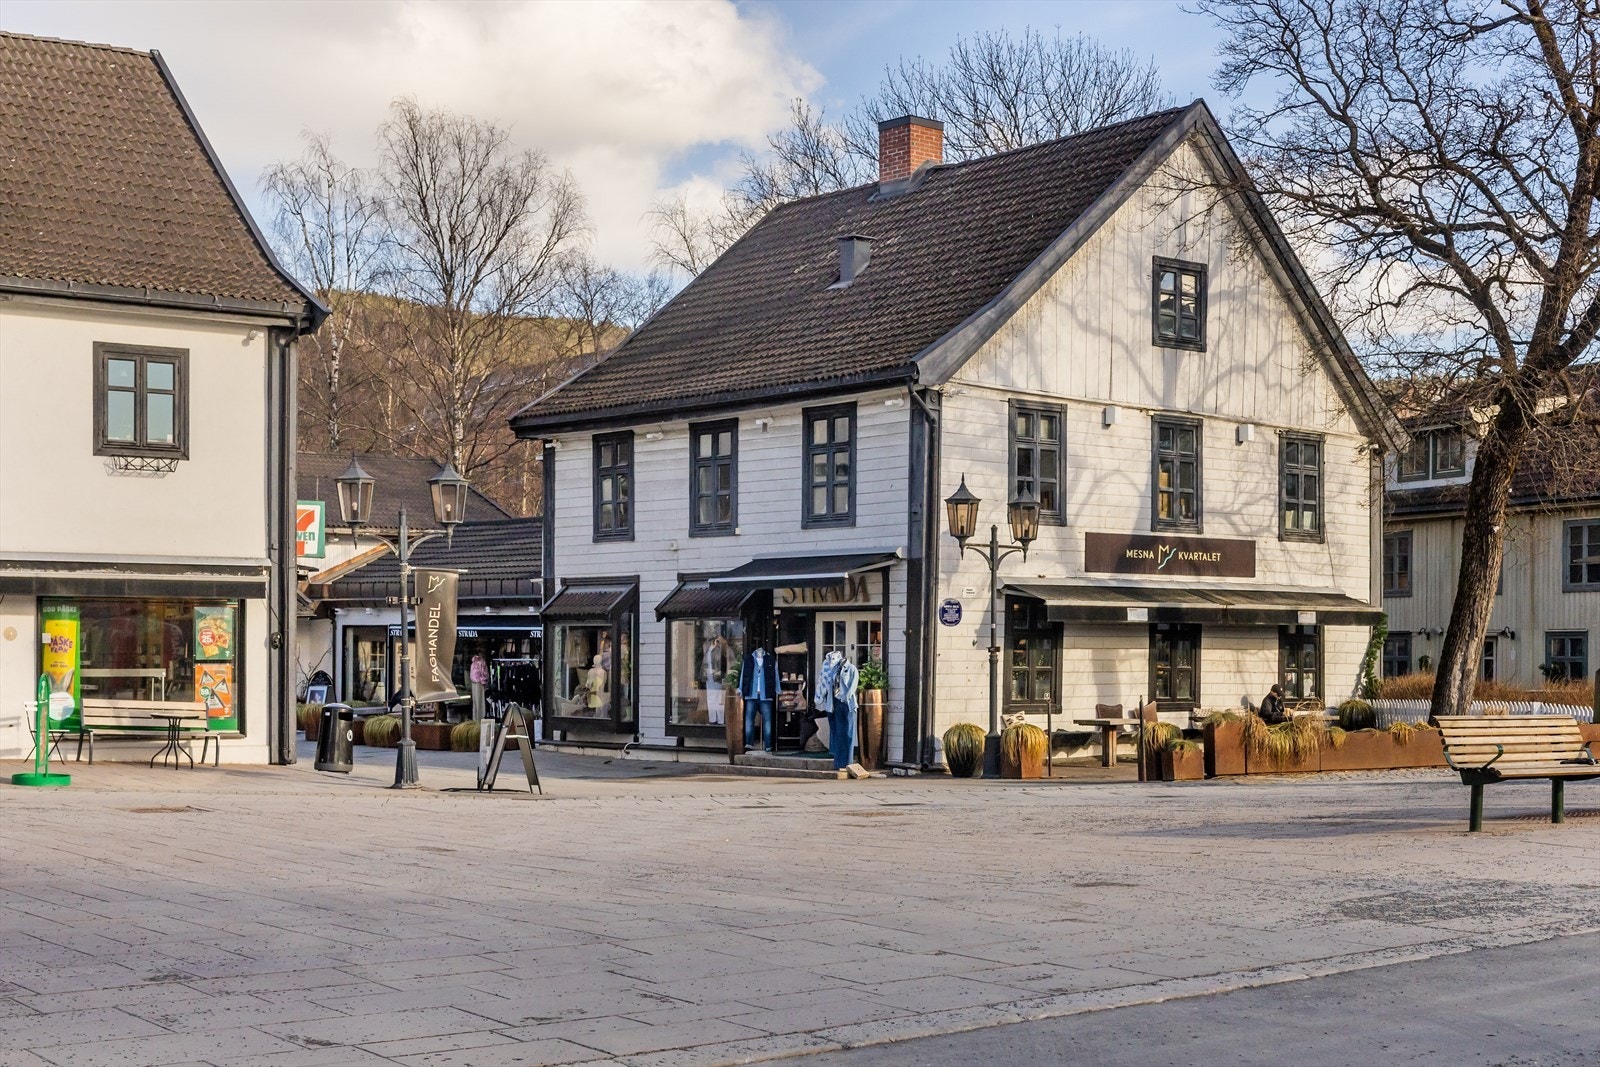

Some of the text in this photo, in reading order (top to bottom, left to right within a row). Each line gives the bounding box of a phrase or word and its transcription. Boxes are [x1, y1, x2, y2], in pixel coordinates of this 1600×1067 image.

[1126, 549, 1154, 560] MESNA
[1178, 551, 1221, 562] KVARTALET
[458, 630, 478, 638] STRADA
[529, 630, 542, 638] STR
[428, 602, 441, 682] FAGHANDEL
